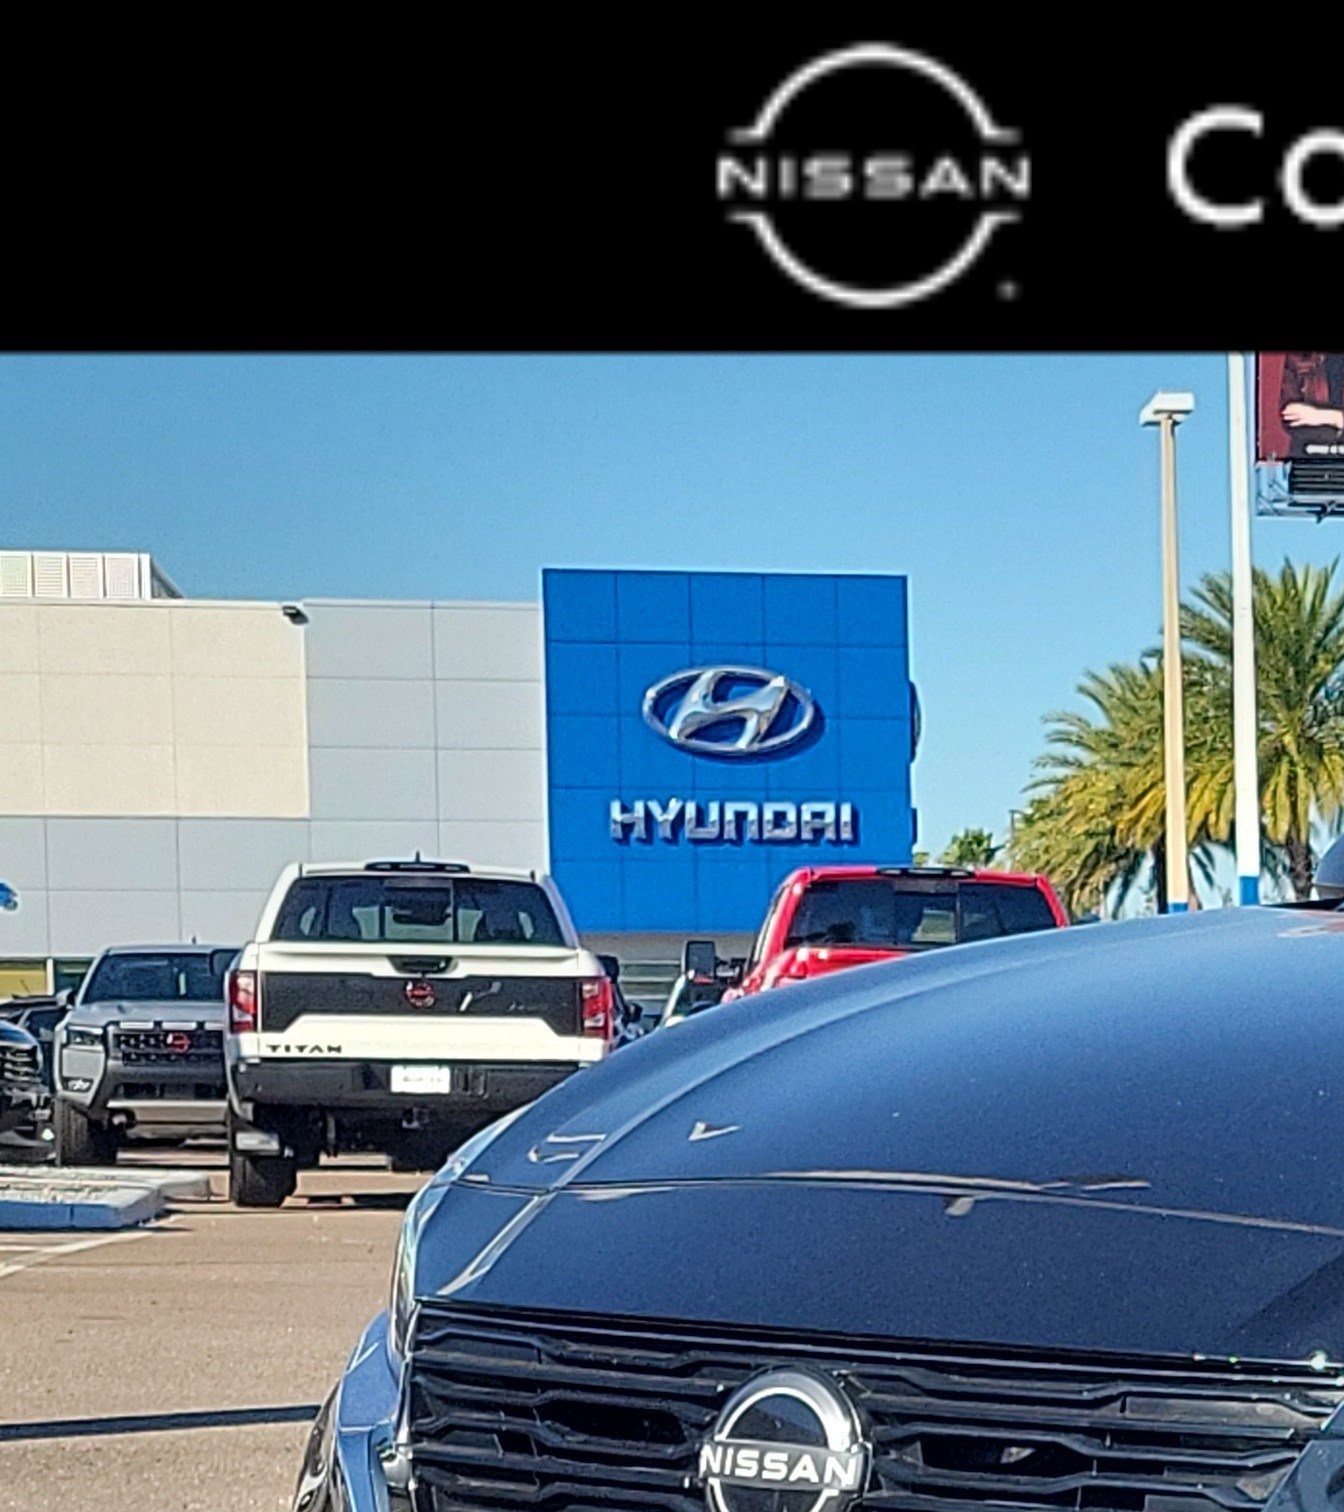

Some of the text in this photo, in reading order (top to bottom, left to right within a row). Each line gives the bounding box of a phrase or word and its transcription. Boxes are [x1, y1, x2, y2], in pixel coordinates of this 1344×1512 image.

[609, 797, 853, 841] HYUNDAI
[265, 1044, 342, 1054] TITAN
[701, 1444, 857, 1488] NISSAN
